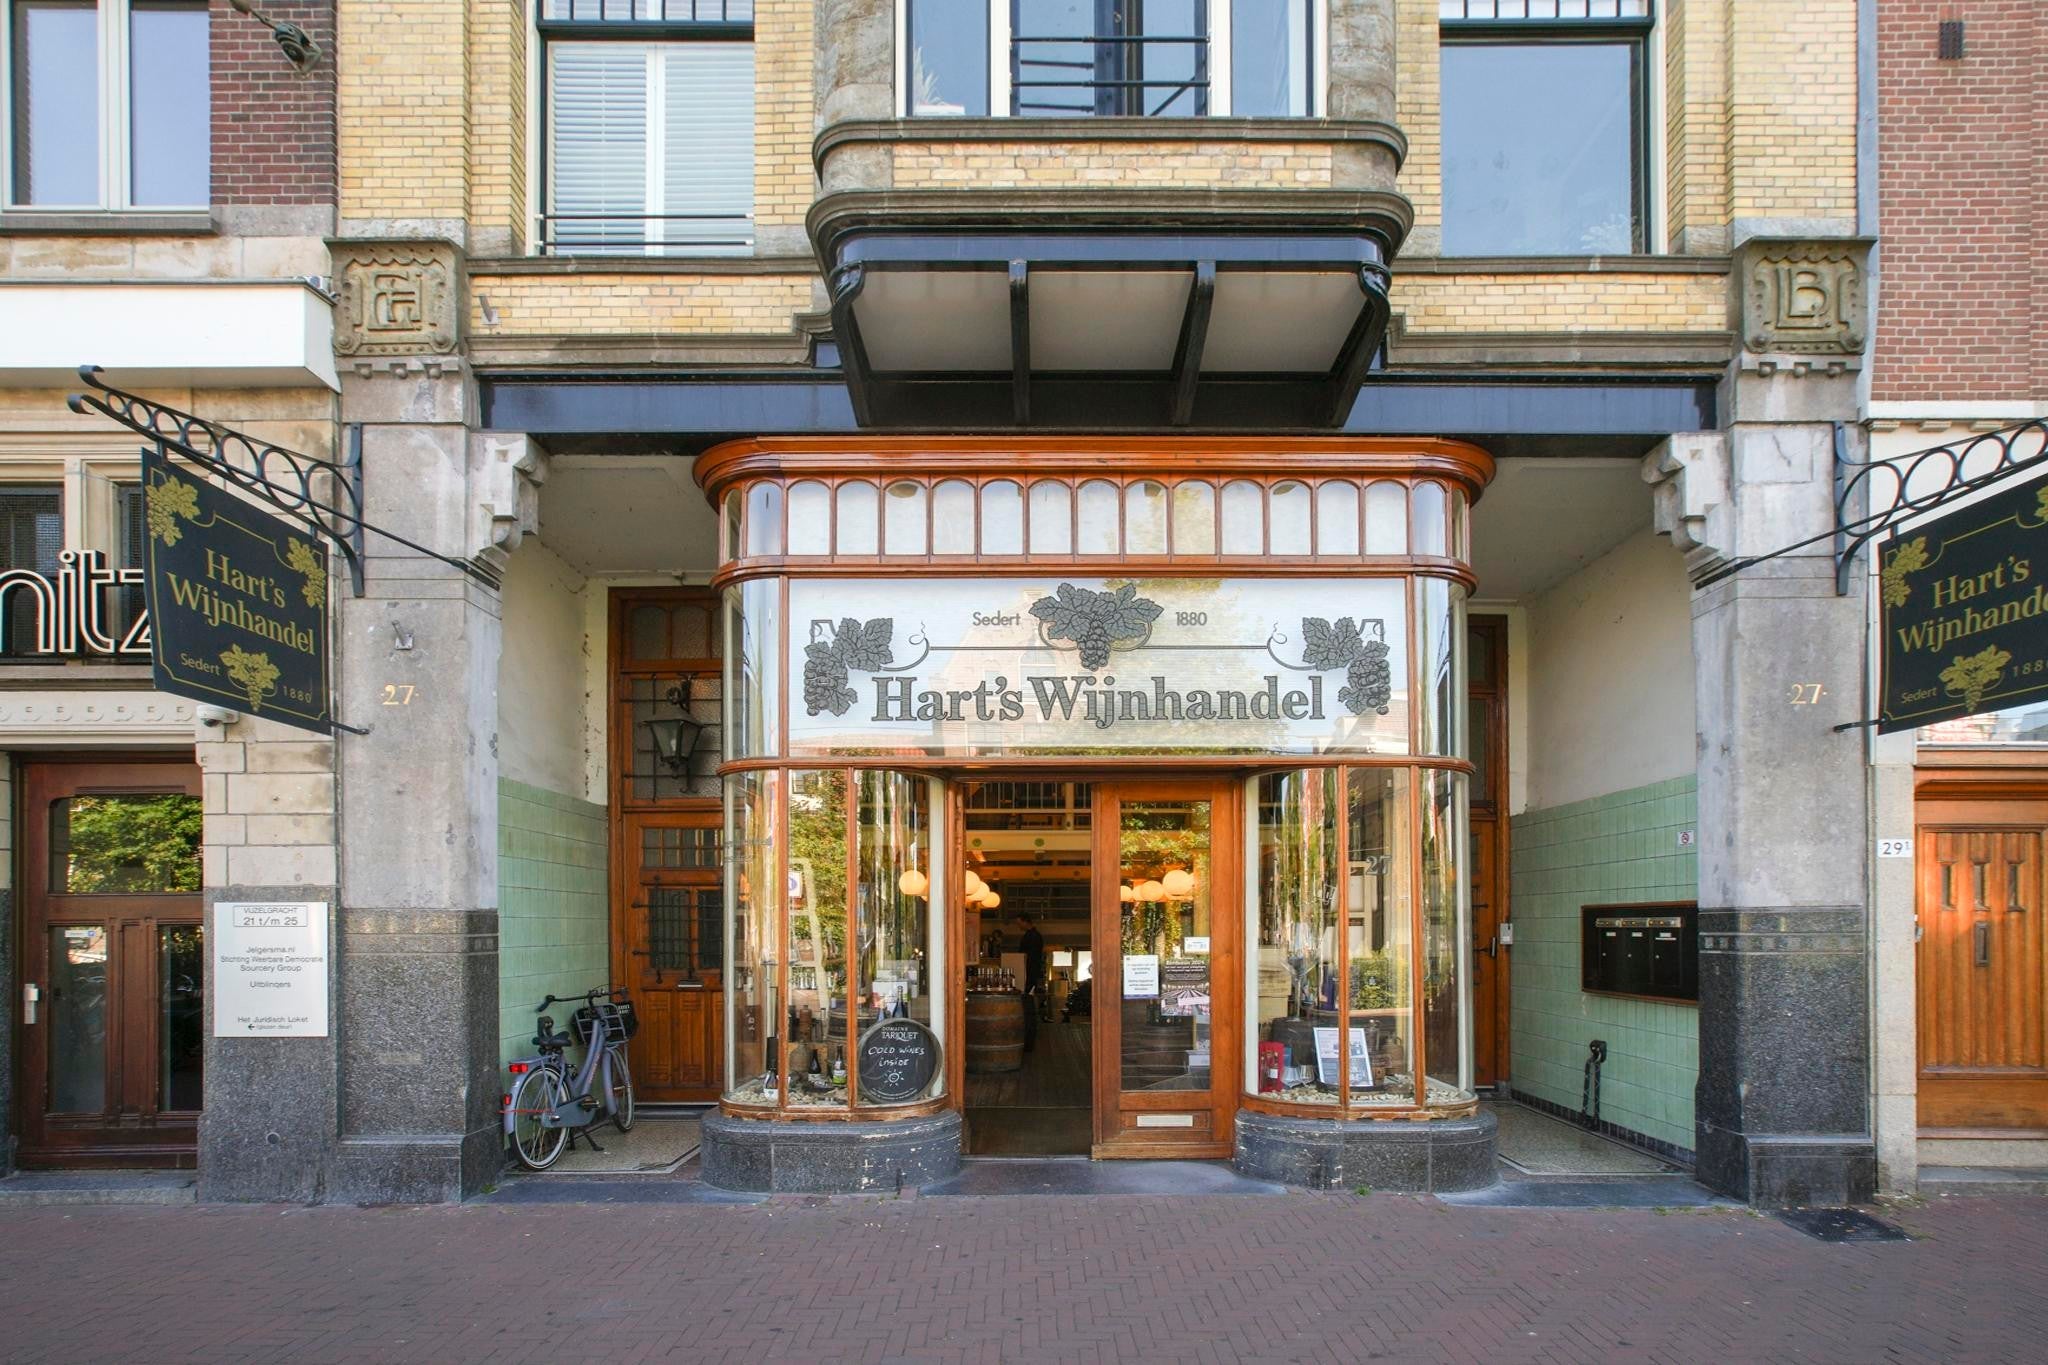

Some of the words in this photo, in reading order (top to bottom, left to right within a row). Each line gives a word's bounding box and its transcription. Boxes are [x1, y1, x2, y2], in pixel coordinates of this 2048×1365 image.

[205, 548, 286, 609] Hart's
[1932, 555, 2030, 609] Hart's
[165, 571, 315, 656] Wijnhandel
[972, 611, 1021, 626] Sedert
[1175, 611, 1208, 626] 1880
[180, 652, 221, 676] Sedert
[283, 685, 313, 704] 1880
[871, 675, 1025, 722] Hart's
[1026, 675, 1326, 729] Wijnhandel
[1901, 687, 1938, 704] Sedert
[2013, 659, 2048, 678] 188
[243, 917, 255, 926] 21
[258, 916, 281, 926] t/m
[283, 916, 298, 926] 25
[277, 964, 302, 973] Group
[881, 1031, 919, 1041] TARIQUET
